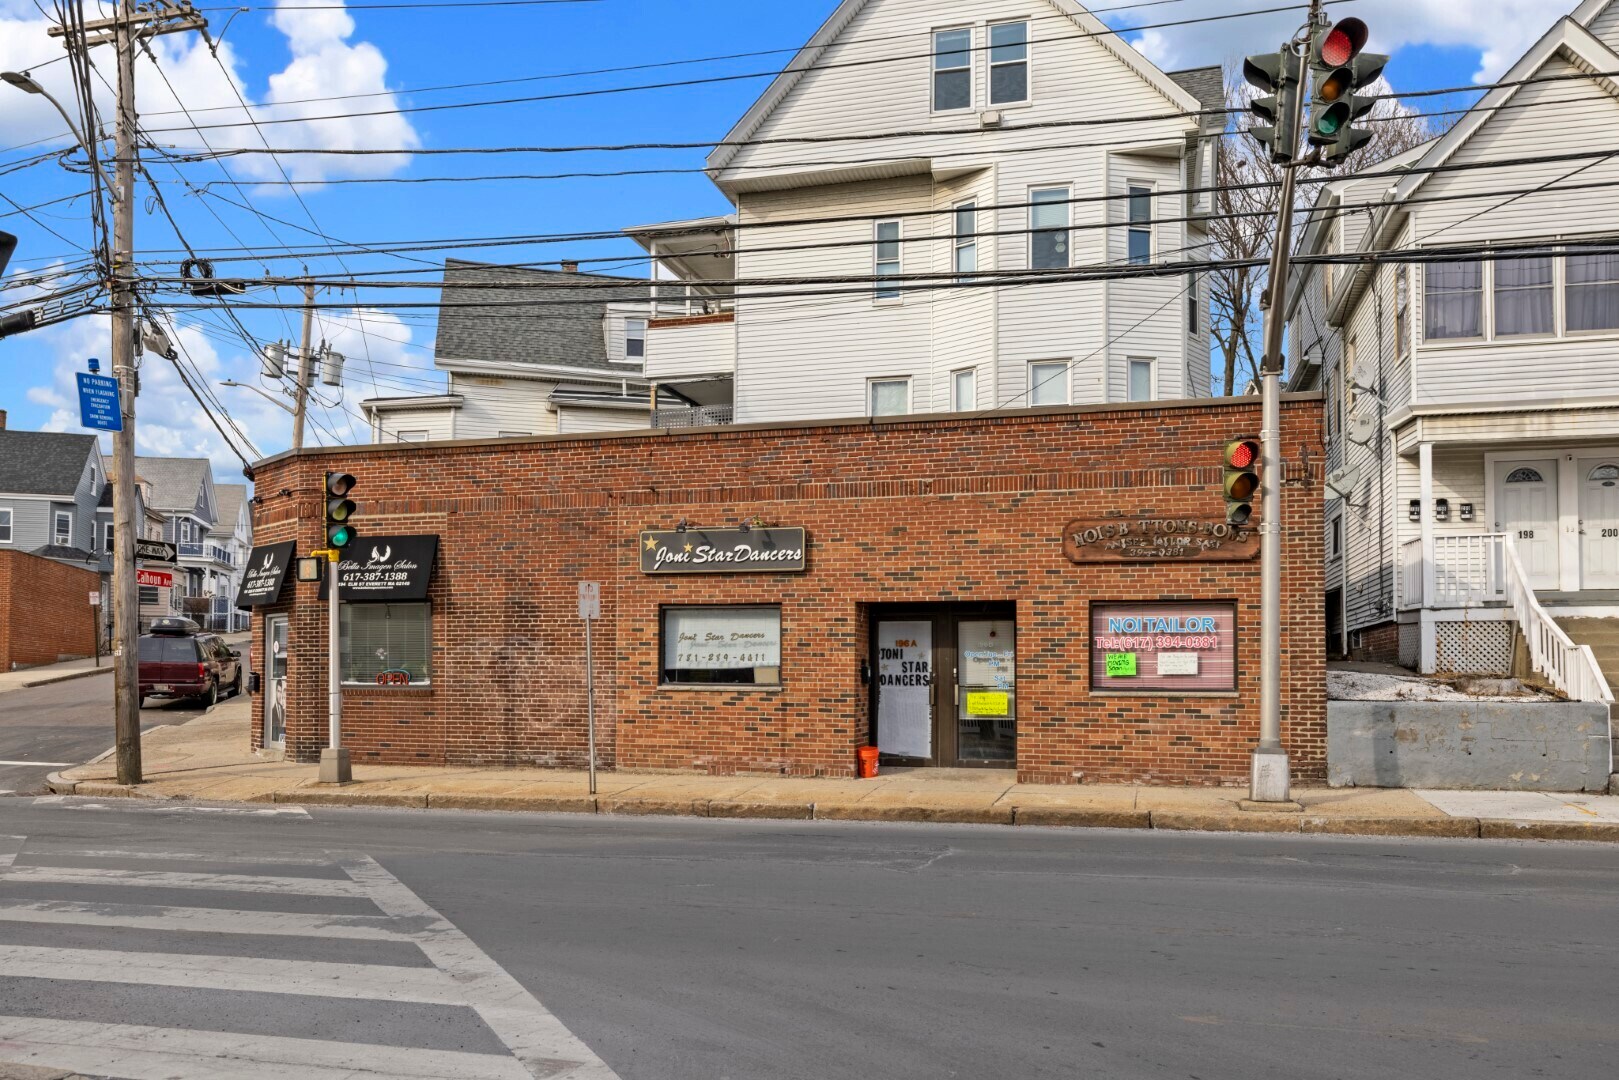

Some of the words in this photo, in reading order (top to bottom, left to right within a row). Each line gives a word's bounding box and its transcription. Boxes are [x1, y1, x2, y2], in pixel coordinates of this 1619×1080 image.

[92, 378, 112, 388] PARKING
[95, 389, 115, 398] FLASHING
[1518, 530, 1534, 539] 198
[1602, 528, 1618, 538] 200
[654, 546, 690, 570] Joni
[338, 560, 360, 571] Bella
[394, 560, 418, 571] Salon
[137, 571, 161, 585] Calhoun
[163, 578, 172, 586] Ave
[343, 572, 408, 582] 617-387-1388
[704, 632, 724, 641] Star
[730, 632, 764, 641] Dancers
[1156, 636, 1218, 648] 394-0381
[880, 648, 903, 660] JONI
[902, 661, 928, 673] STAR
[376, 672, 409, 685] OPEN
[880, 674, 929, 686] DANCERS
